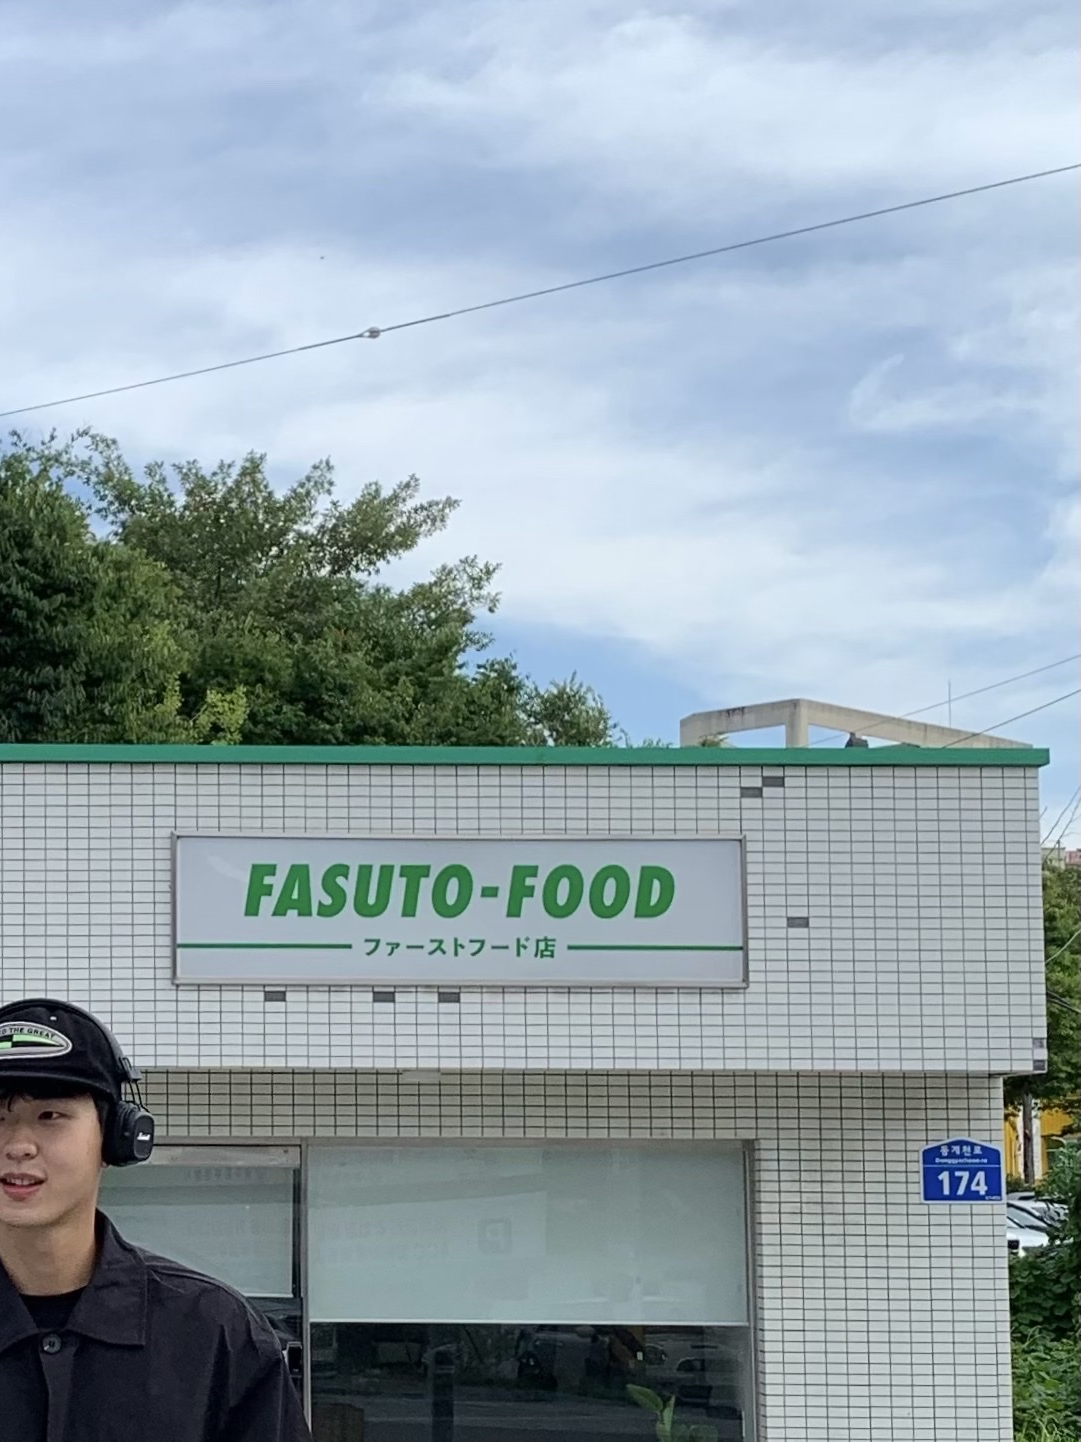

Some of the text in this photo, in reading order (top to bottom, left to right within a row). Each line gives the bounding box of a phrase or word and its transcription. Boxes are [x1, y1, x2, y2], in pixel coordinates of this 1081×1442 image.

[244, 863, 675, 919] FASUTO-FOOD
[364, 936, 557, 959] ファーストフード店
[27, 1028, 54, 1039] GREAT
[938, 1170, 988, 1196] 174
